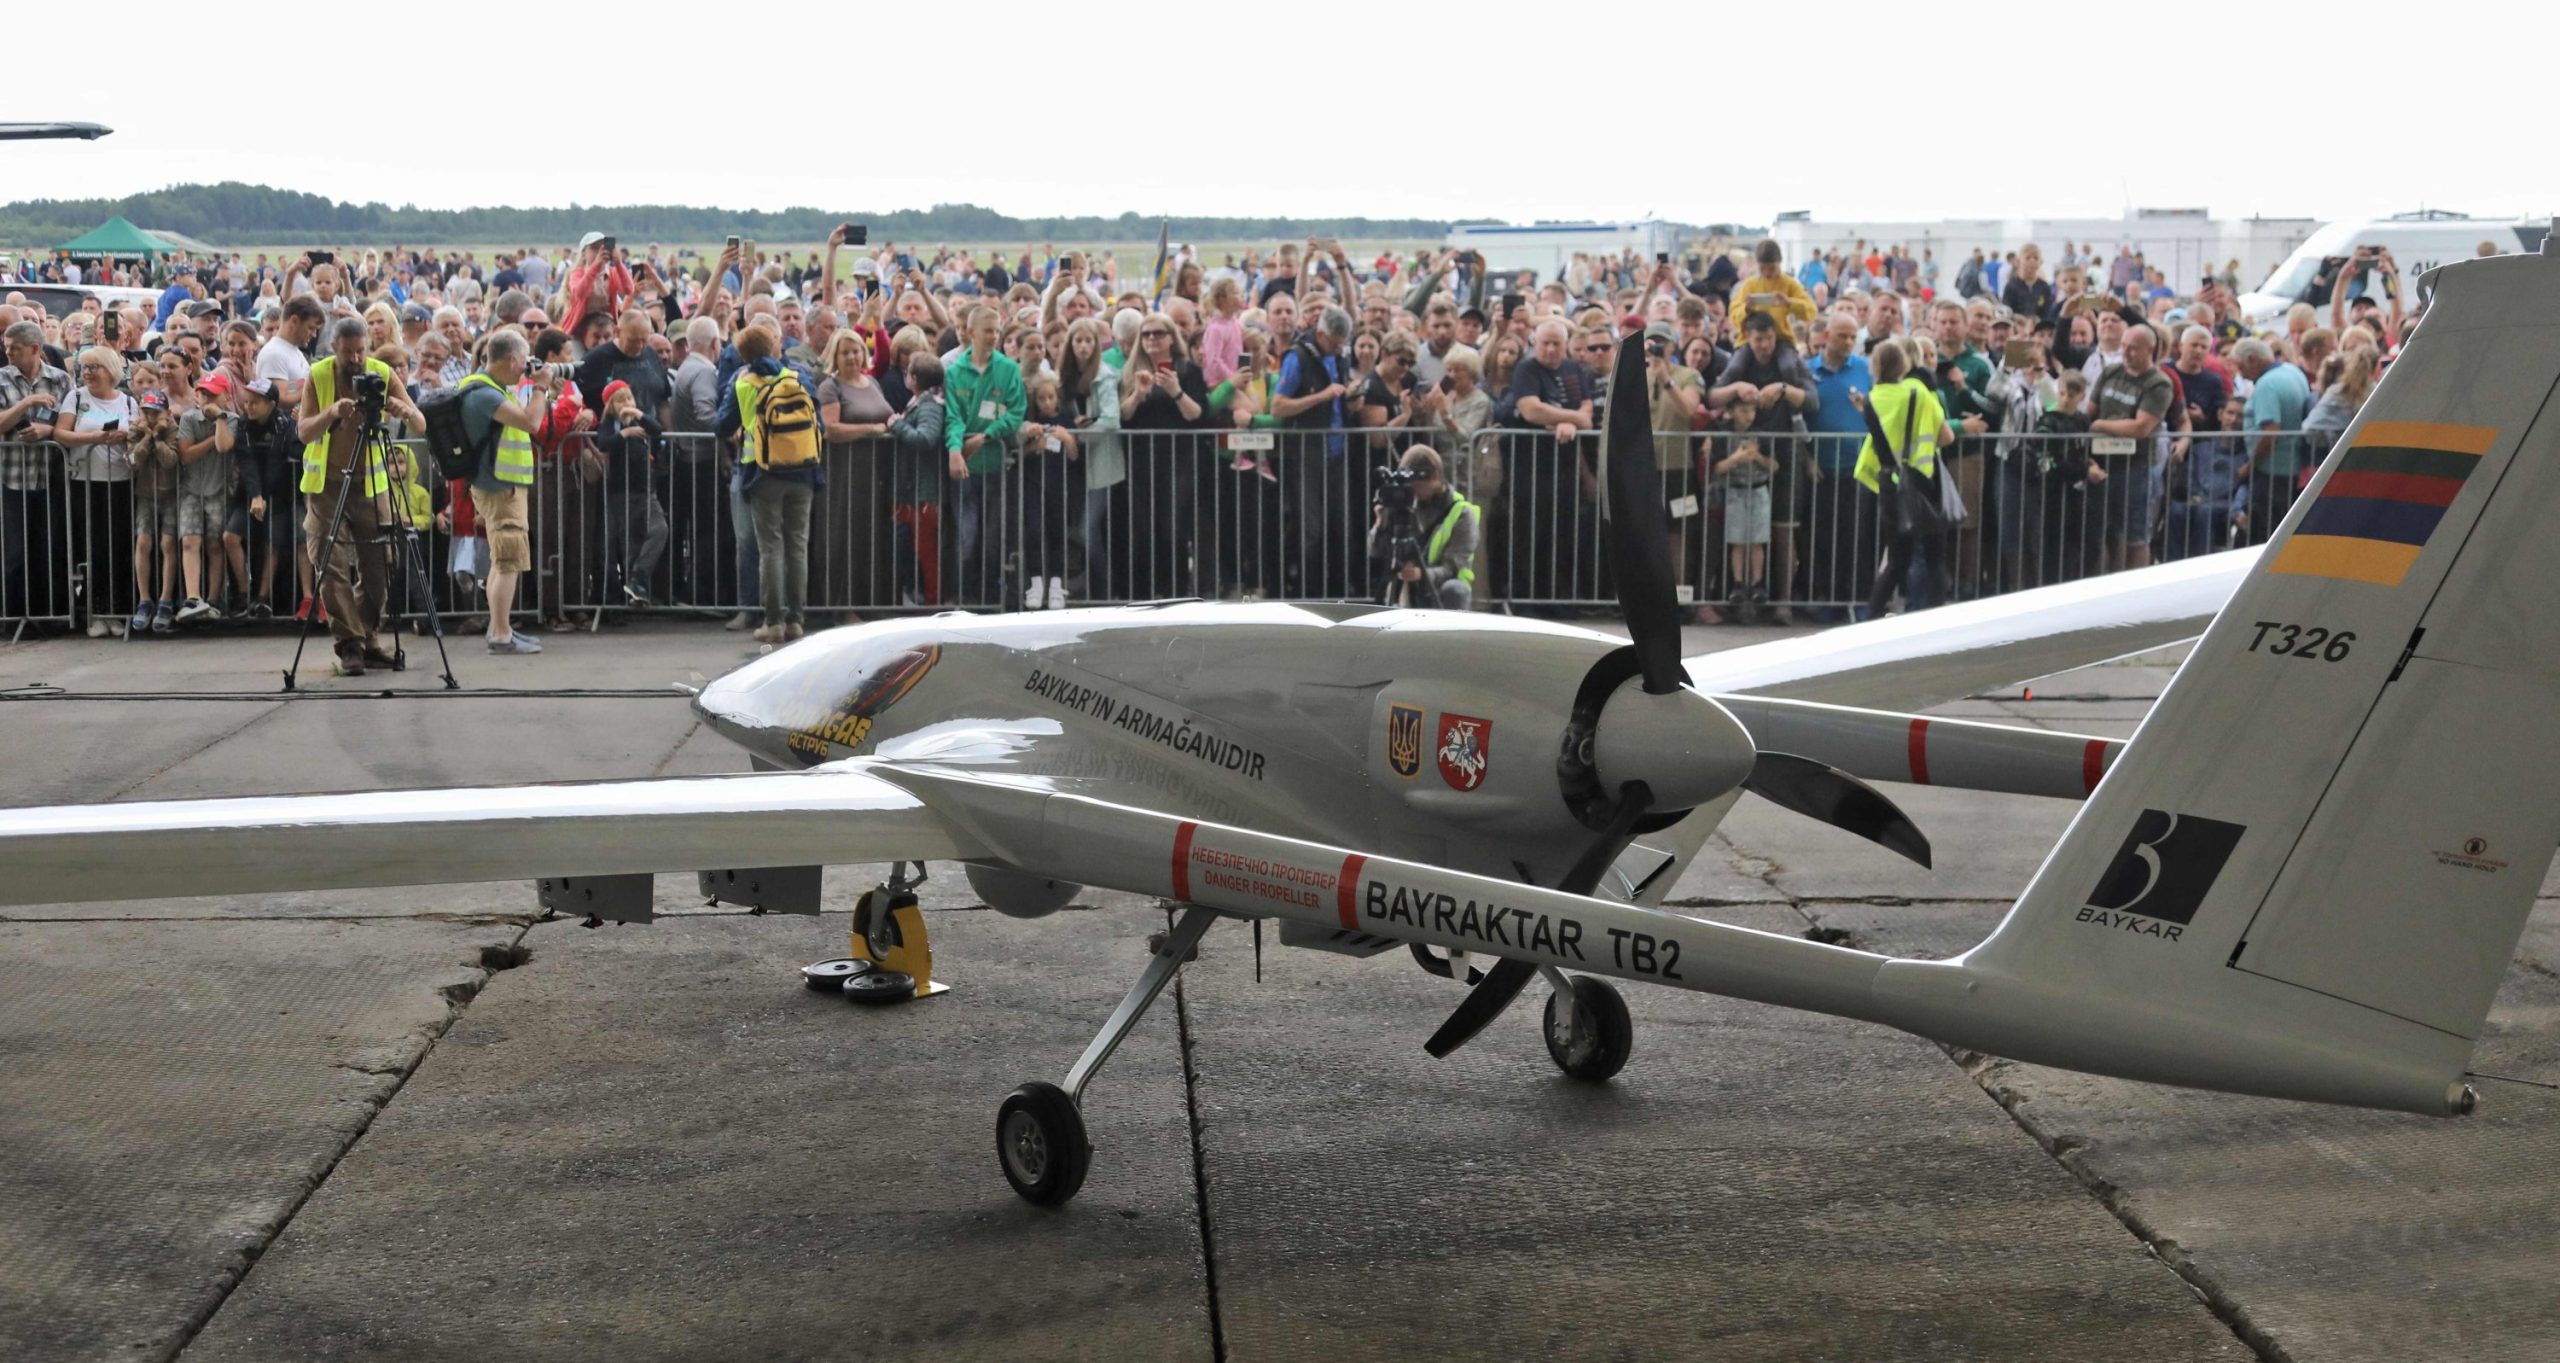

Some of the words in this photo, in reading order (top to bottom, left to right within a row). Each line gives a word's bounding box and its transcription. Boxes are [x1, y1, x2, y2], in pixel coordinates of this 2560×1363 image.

[2248, 621, 2357, 662] T326
[788, 732, 829, 757] ЯСТРУБ
[1112, 704, 1265, 780] ARMAĞANIDIR
[1192, 847, 1268, 876] НЕБЕЗПЕЧНО
[1271, 863, 1336, 889] ПРОПЕЛЕР
[1204, 870, 1250, 893] DANGER
[1253, 881, 1320, 908] PROPELLER
[1366, 880, 1586, 962] BAYRAKTAR
[1607, 927, 1683, 980] TB2
[2075, 907, 2184, 942] BAYKAR
